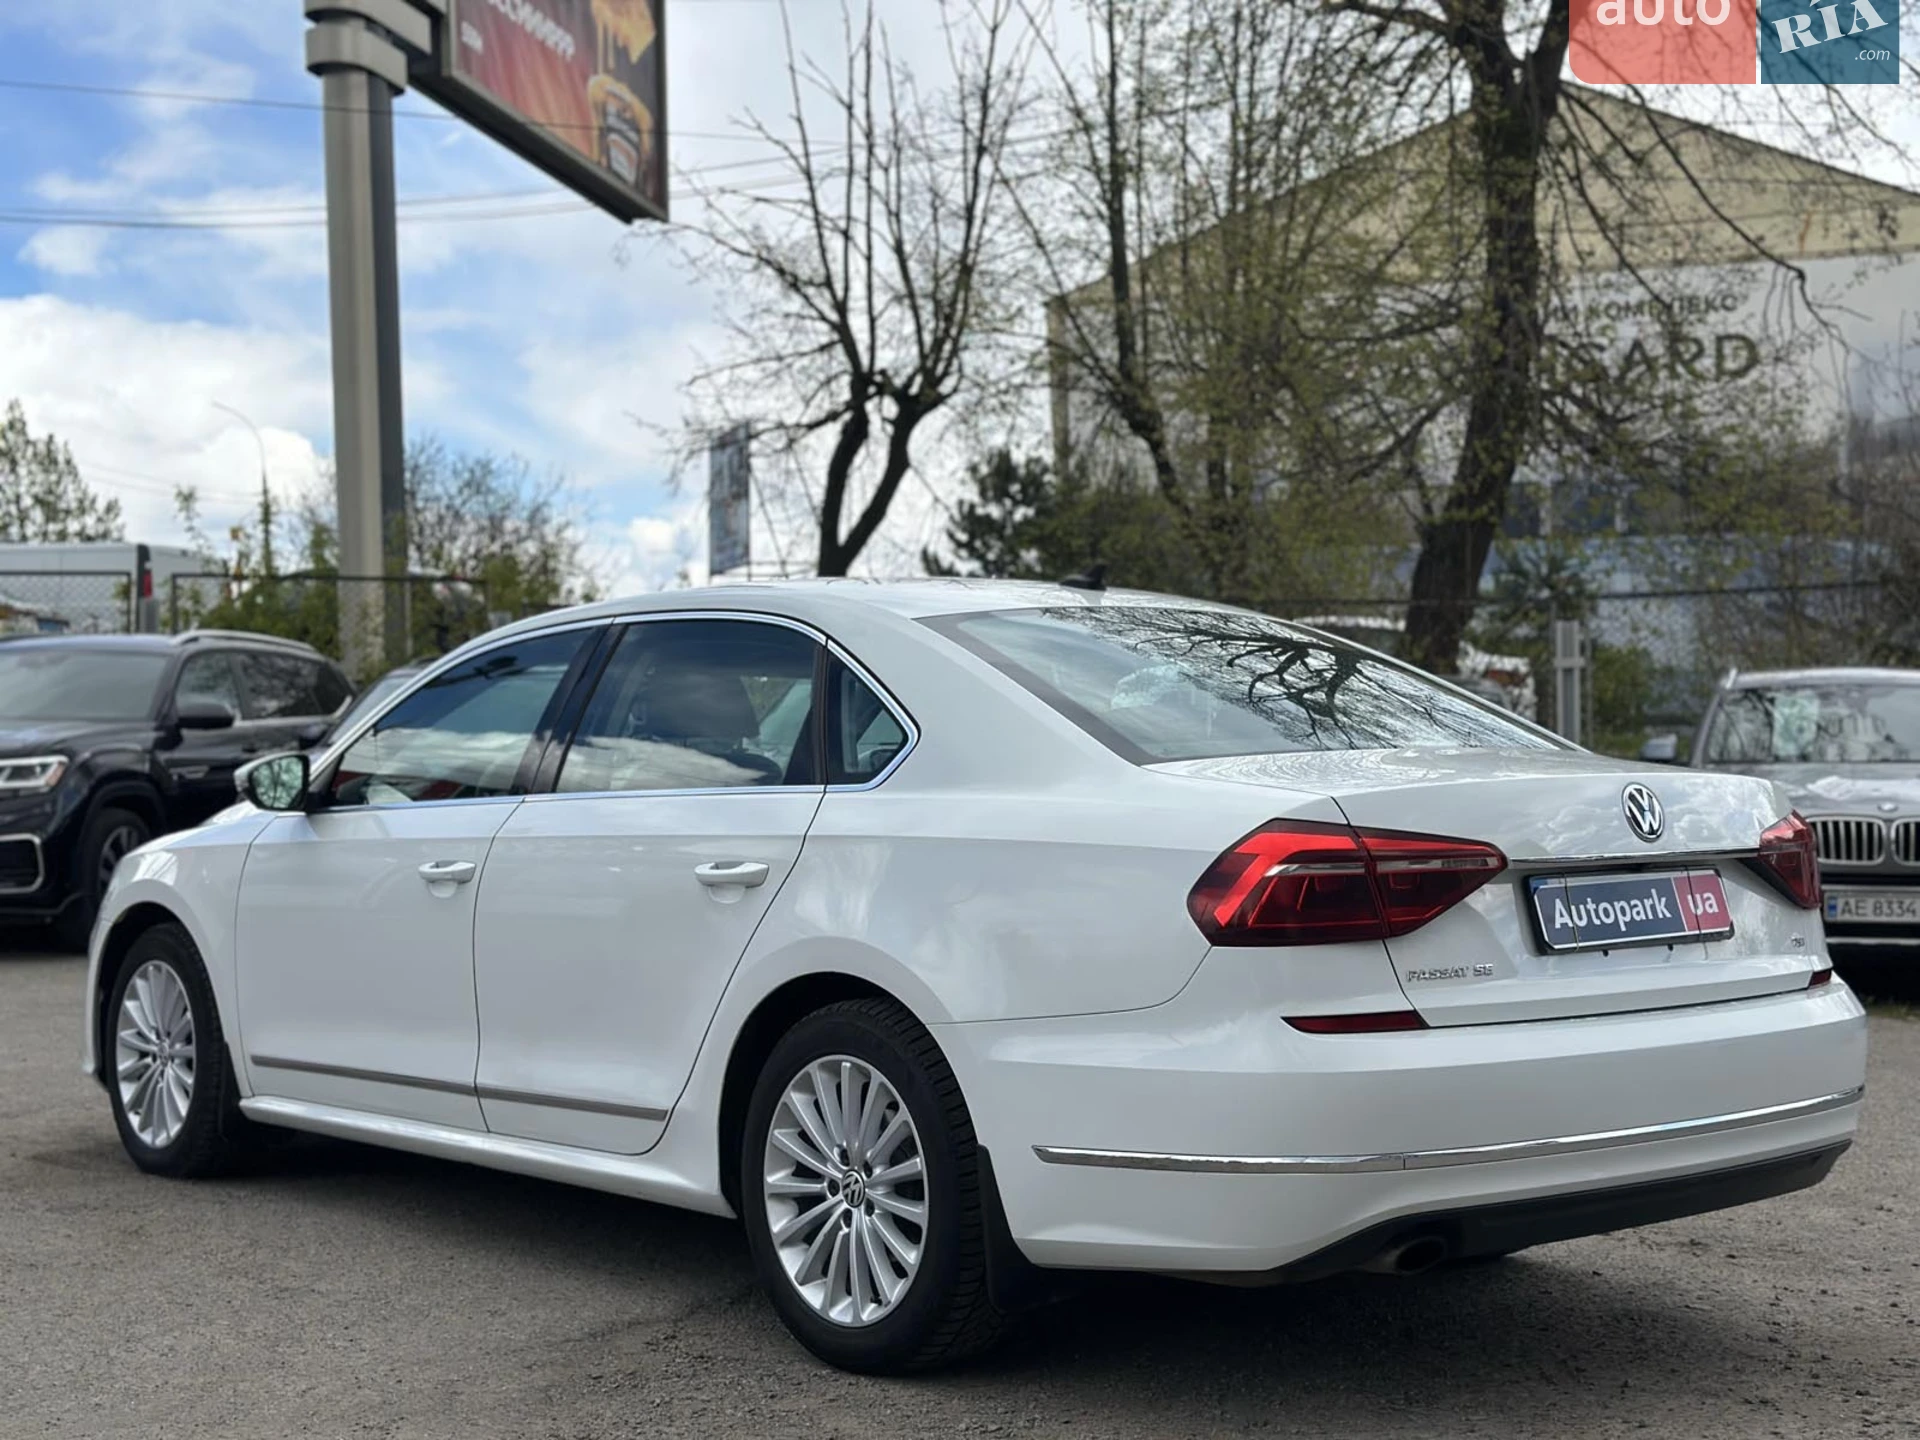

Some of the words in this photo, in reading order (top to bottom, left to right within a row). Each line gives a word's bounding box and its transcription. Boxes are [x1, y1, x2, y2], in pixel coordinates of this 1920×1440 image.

[1553, 888, 1673, 932] Autopark
[1687, 891, 1719, 916] ua
[1841, 900, 1868, 917] AE
[1406, 966, 1469, 982] PASSAT
[1473, 963, 1494, 977] SE
